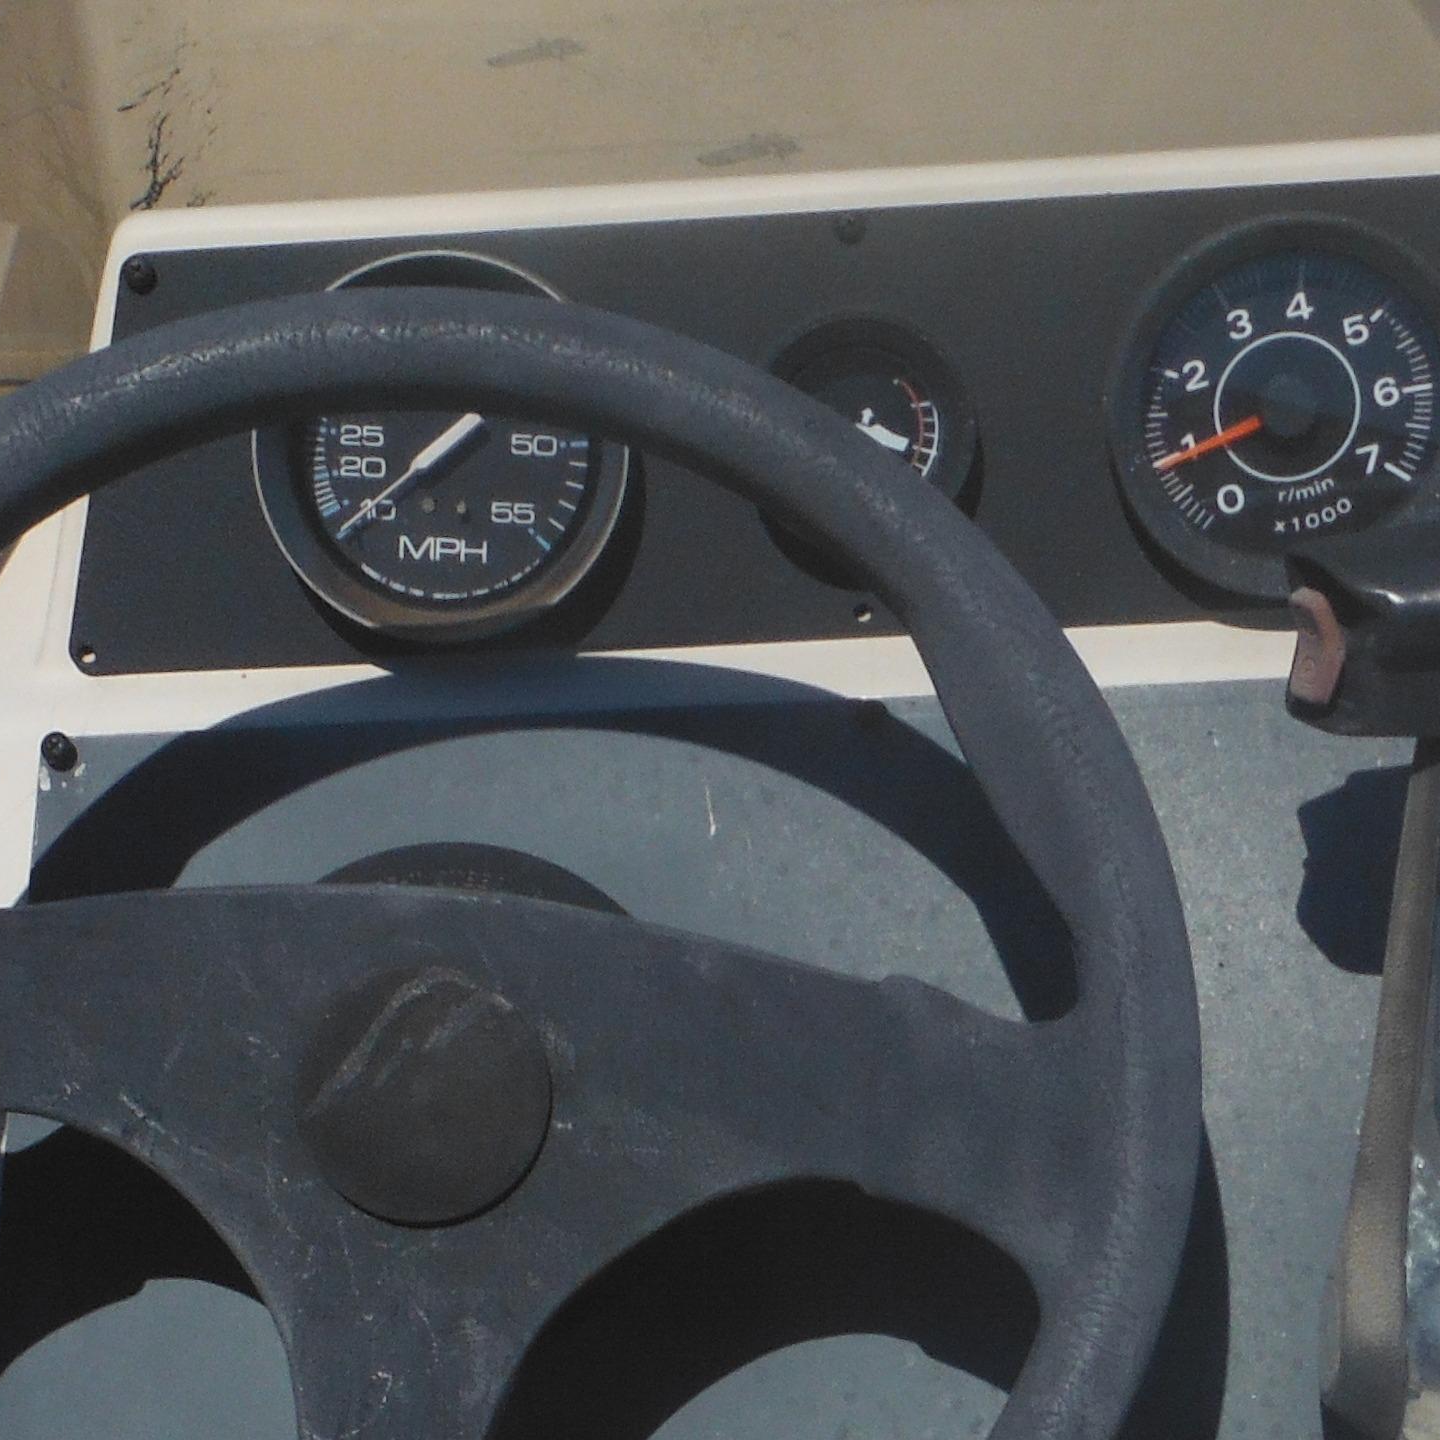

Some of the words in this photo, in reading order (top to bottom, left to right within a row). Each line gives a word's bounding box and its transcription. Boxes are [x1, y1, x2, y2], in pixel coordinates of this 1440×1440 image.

[1286, 292, 1313, 320] 4
[1226, 309, 1253, 340] 3
[1342, 315, 1369, 345] 5
[1182, 360, 1209, 392] 2
[1373, 377, 1400, 407] 6
[340, 425, 384, 447] 25
[511, 434, 558, 456] 50
[340, 457, 386, 478] 20
[1356, 444, 1380, 474] 7
[1217, 484, 1246, 514] 0
[1278, 477, 1335, 502] r/min
[360, 498, 396, 520] 10
[491, 503, 535, 524] 55
[399, 535, 488, 564] MPH
